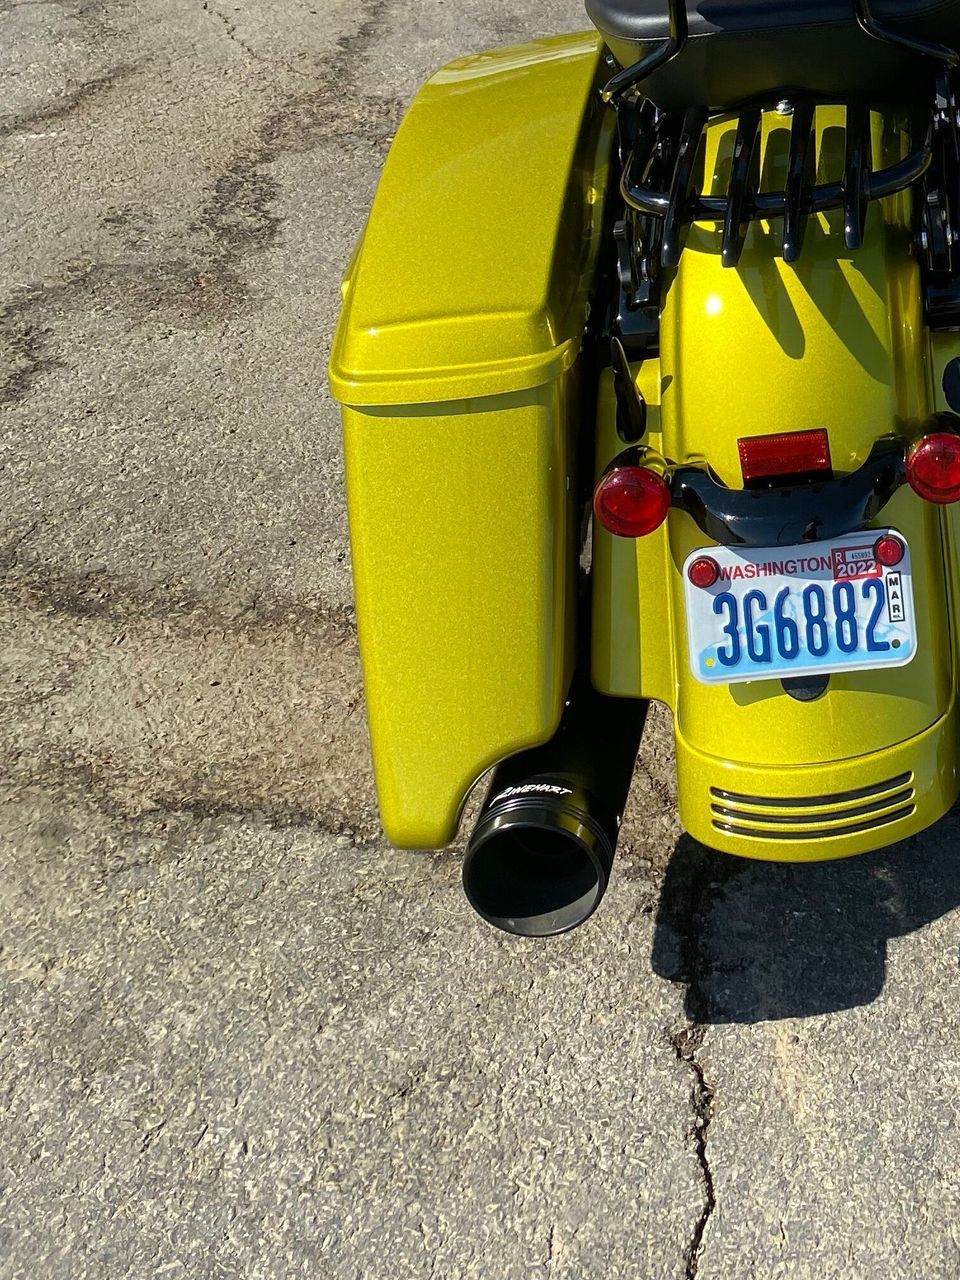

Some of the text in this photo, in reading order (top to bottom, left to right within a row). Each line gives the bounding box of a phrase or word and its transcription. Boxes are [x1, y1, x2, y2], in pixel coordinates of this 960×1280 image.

[717, 555, 831, 581] WASHINGTON
[837, 560, 878, 578] 2022
[713, 577, 891, 667] 3G6882
[488, 783, 573, 808] RINEHART
